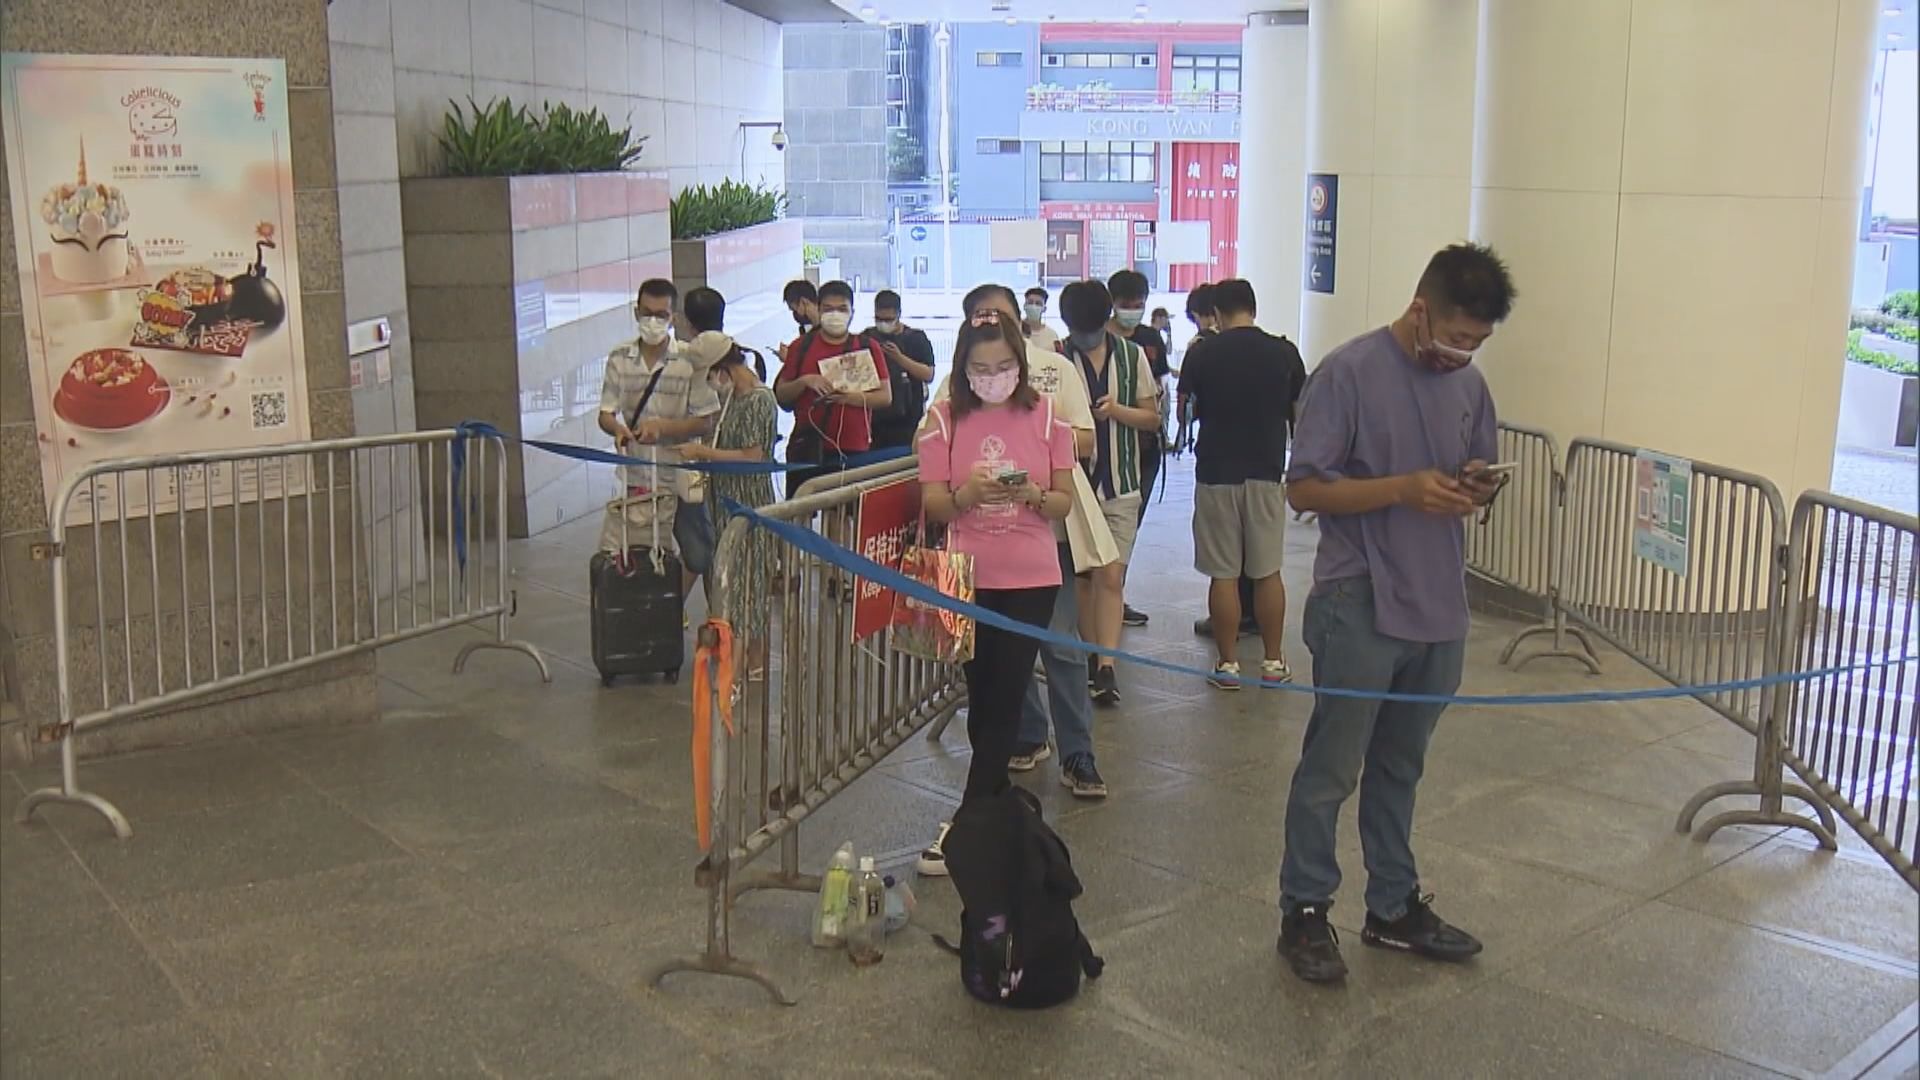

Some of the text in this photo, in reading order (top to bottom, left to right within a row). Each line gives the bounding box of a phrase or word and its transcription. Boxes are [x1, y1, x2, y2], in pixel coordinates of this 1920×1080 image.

[120, 86, 182, 109] Cakelicious
[1087, 118, 1148, 134] KONG
[1166, 118, 1212, 135] WAN
[1053, 211, 1073, 220] KONG
[1077, 211, 1093, 220] WAN
